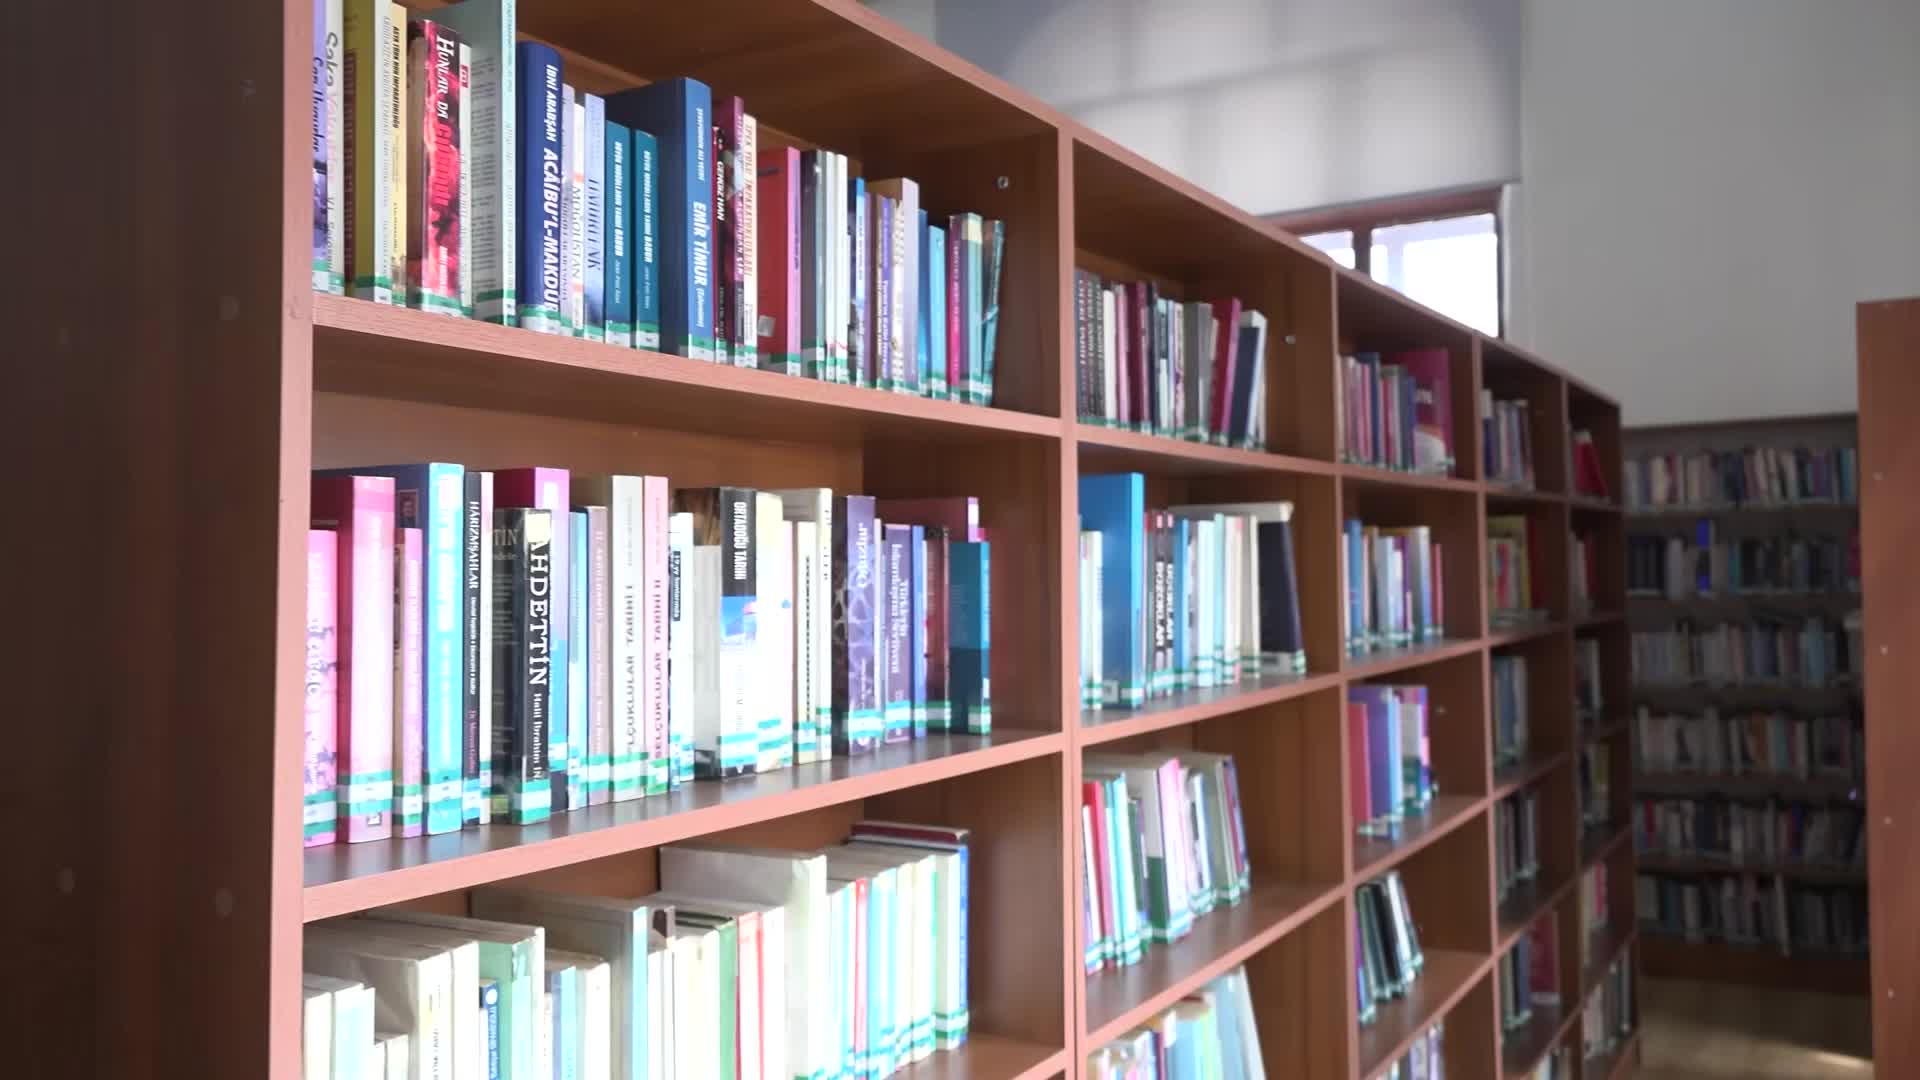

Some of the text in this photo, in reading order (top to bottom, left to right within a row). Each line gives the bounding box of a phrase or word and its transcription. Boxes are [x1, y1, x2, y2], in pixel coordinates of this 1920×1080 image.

[435, 35, 455, 94] HUNLAR
[437, 101, 448, 120] DA
[544, 64, 558, 142] İBNİ ARABŞAH
[693, 201, 711, 238] EMİR
[717, 197, 725, 221] HAN
[614, 229, 623, 257] BABUR
[643, 236, 653, 263] BABUR
[693, 239, 711, 287] TİMUR
